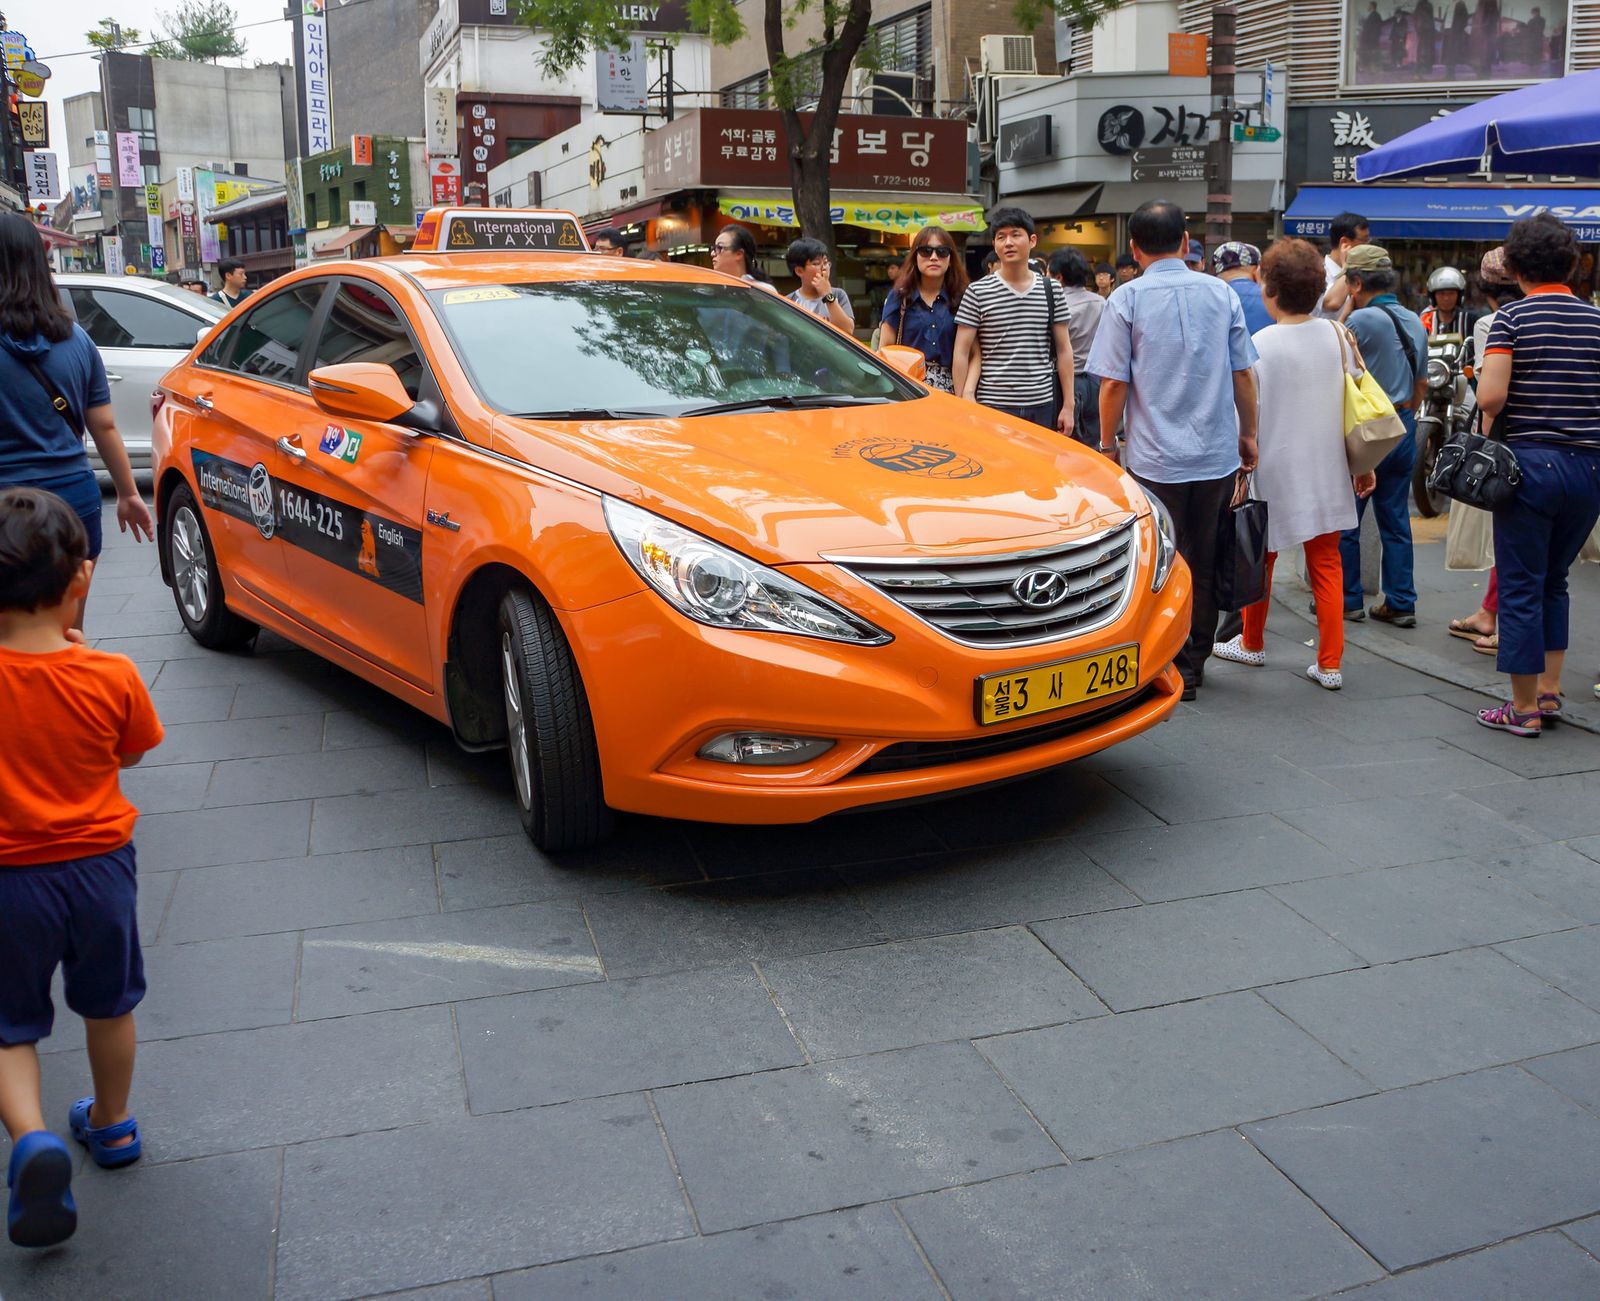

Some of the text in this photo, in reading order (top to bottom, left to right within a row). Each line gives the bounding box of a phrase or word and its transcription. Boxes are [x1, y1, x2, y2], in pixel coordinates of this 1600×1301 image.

[307, 23, 329, 152] 인사아트프라자
[720, 129, 776, 144] 서화·골동
[664, 125, 693, 173] 삼보당
[720, 146, 776, 161] 무료감정
[873, 175, 931, 187] T.722-1052
[1496, 204, 1600, 218] VISA
[473, 220, 556, 235] International
[1296, 222, 1325, 234] 성문당
[485, 233, 549, 247] TAXI
[831, 436, 949, 459] International
[883, 448, 951, 471] TAXI
[199, 465, 344, 541] International TAXI 1644-225
[378, 522, 405, 548] English
[1013, 677, 1029, 711] 3
[1048, 671, 1064, 700] 사
[1086, 654, 1128, 694] 248
